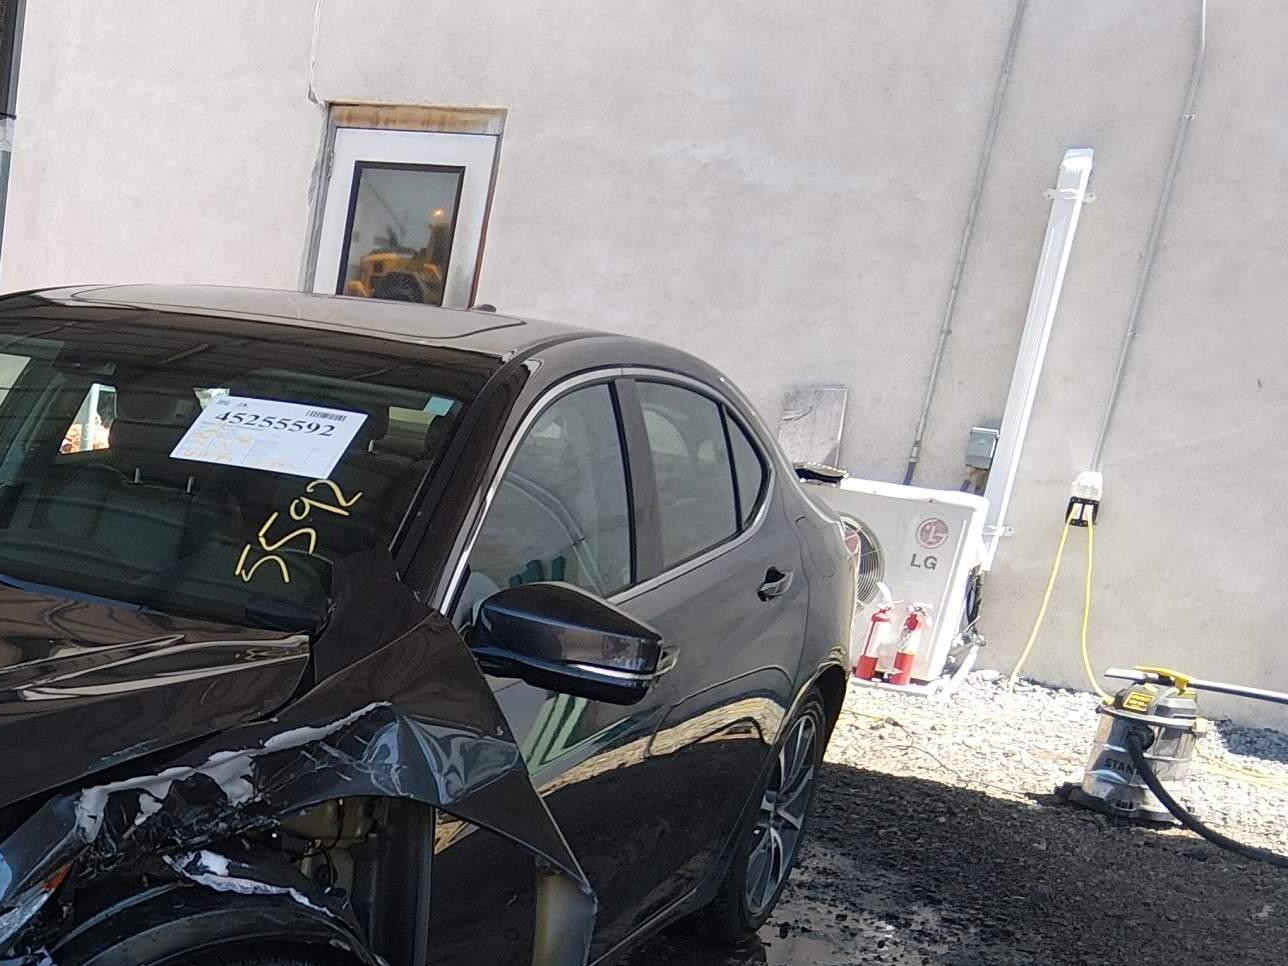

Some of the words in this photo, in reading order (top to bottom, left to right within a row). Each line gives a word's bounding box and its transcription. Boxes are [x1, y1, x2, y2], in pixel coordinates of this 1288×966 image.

[215, 410, 335, 437] 45255592
[235, 479, 363, 583] 5592
[910, 553, 938, 570] LG
[1104, 758, 1139, 775] STAN
